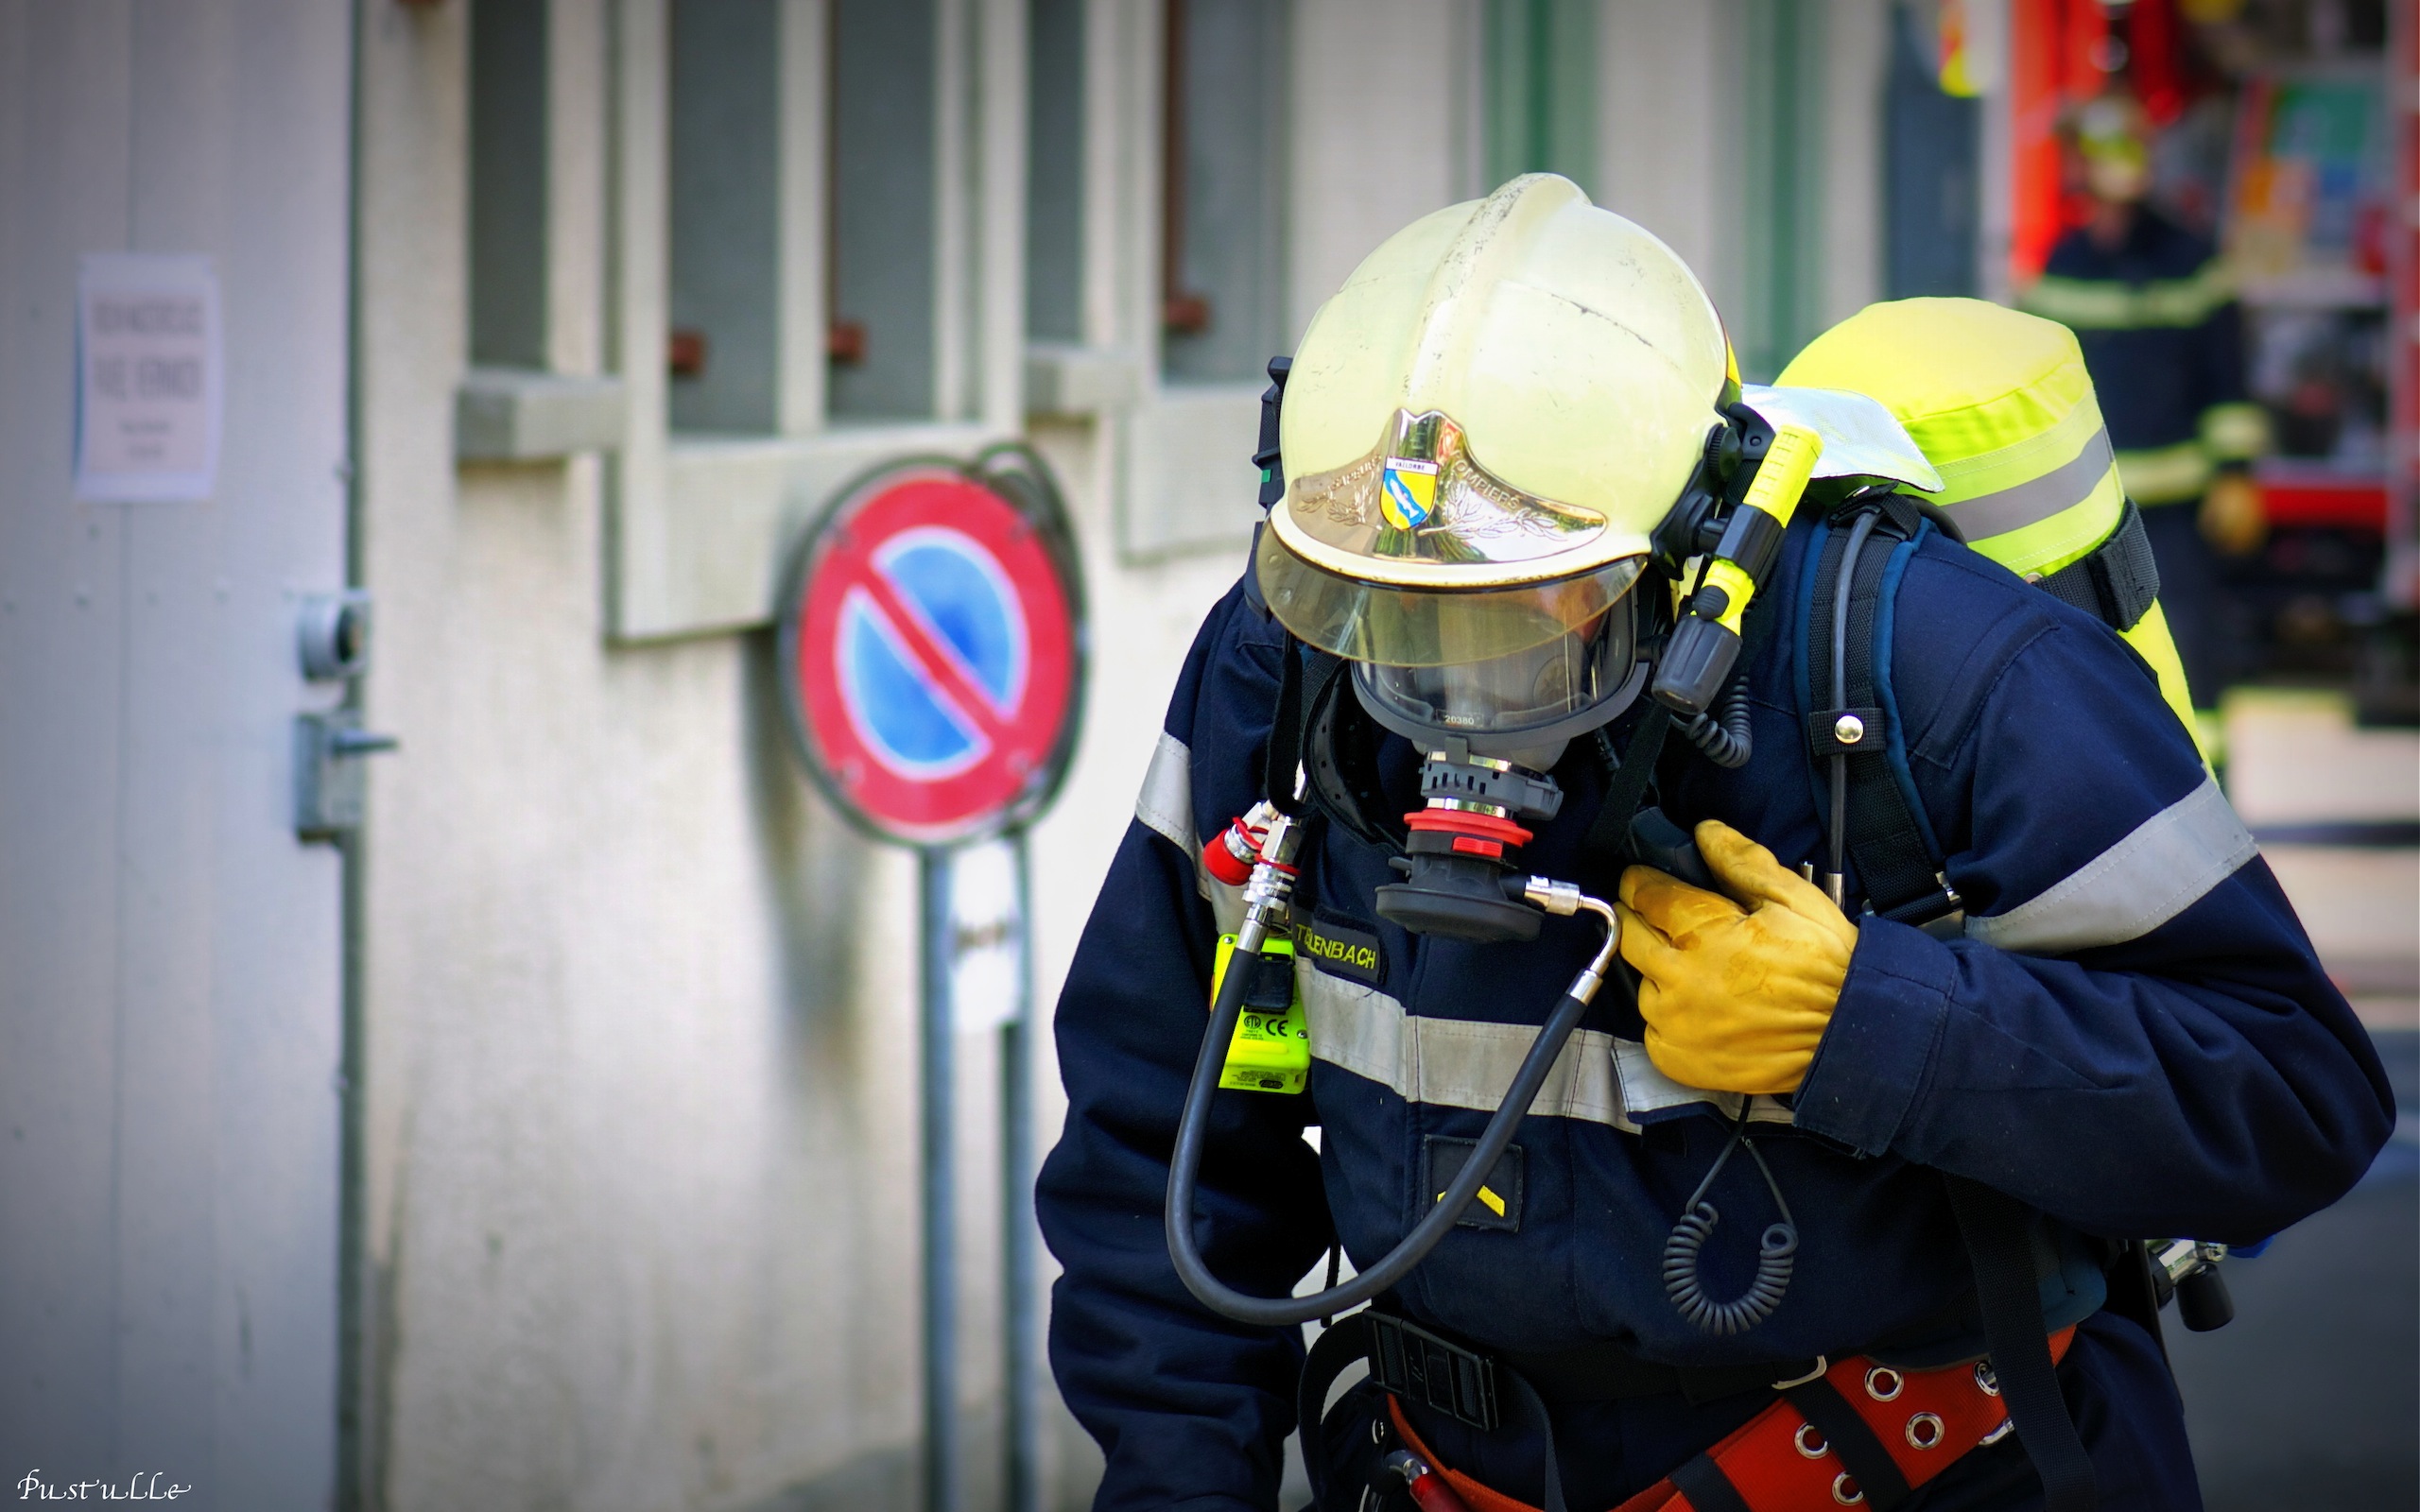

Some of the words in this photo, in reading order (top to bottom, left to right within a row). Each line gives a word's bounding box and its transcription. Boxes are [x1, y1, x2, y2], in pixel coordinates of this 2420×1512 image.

[1450, 450, 1520, 509] POMPIERS
[1444, 714, 1475, 726] 20380
[1266, 1019, 1288, 1037] CE
